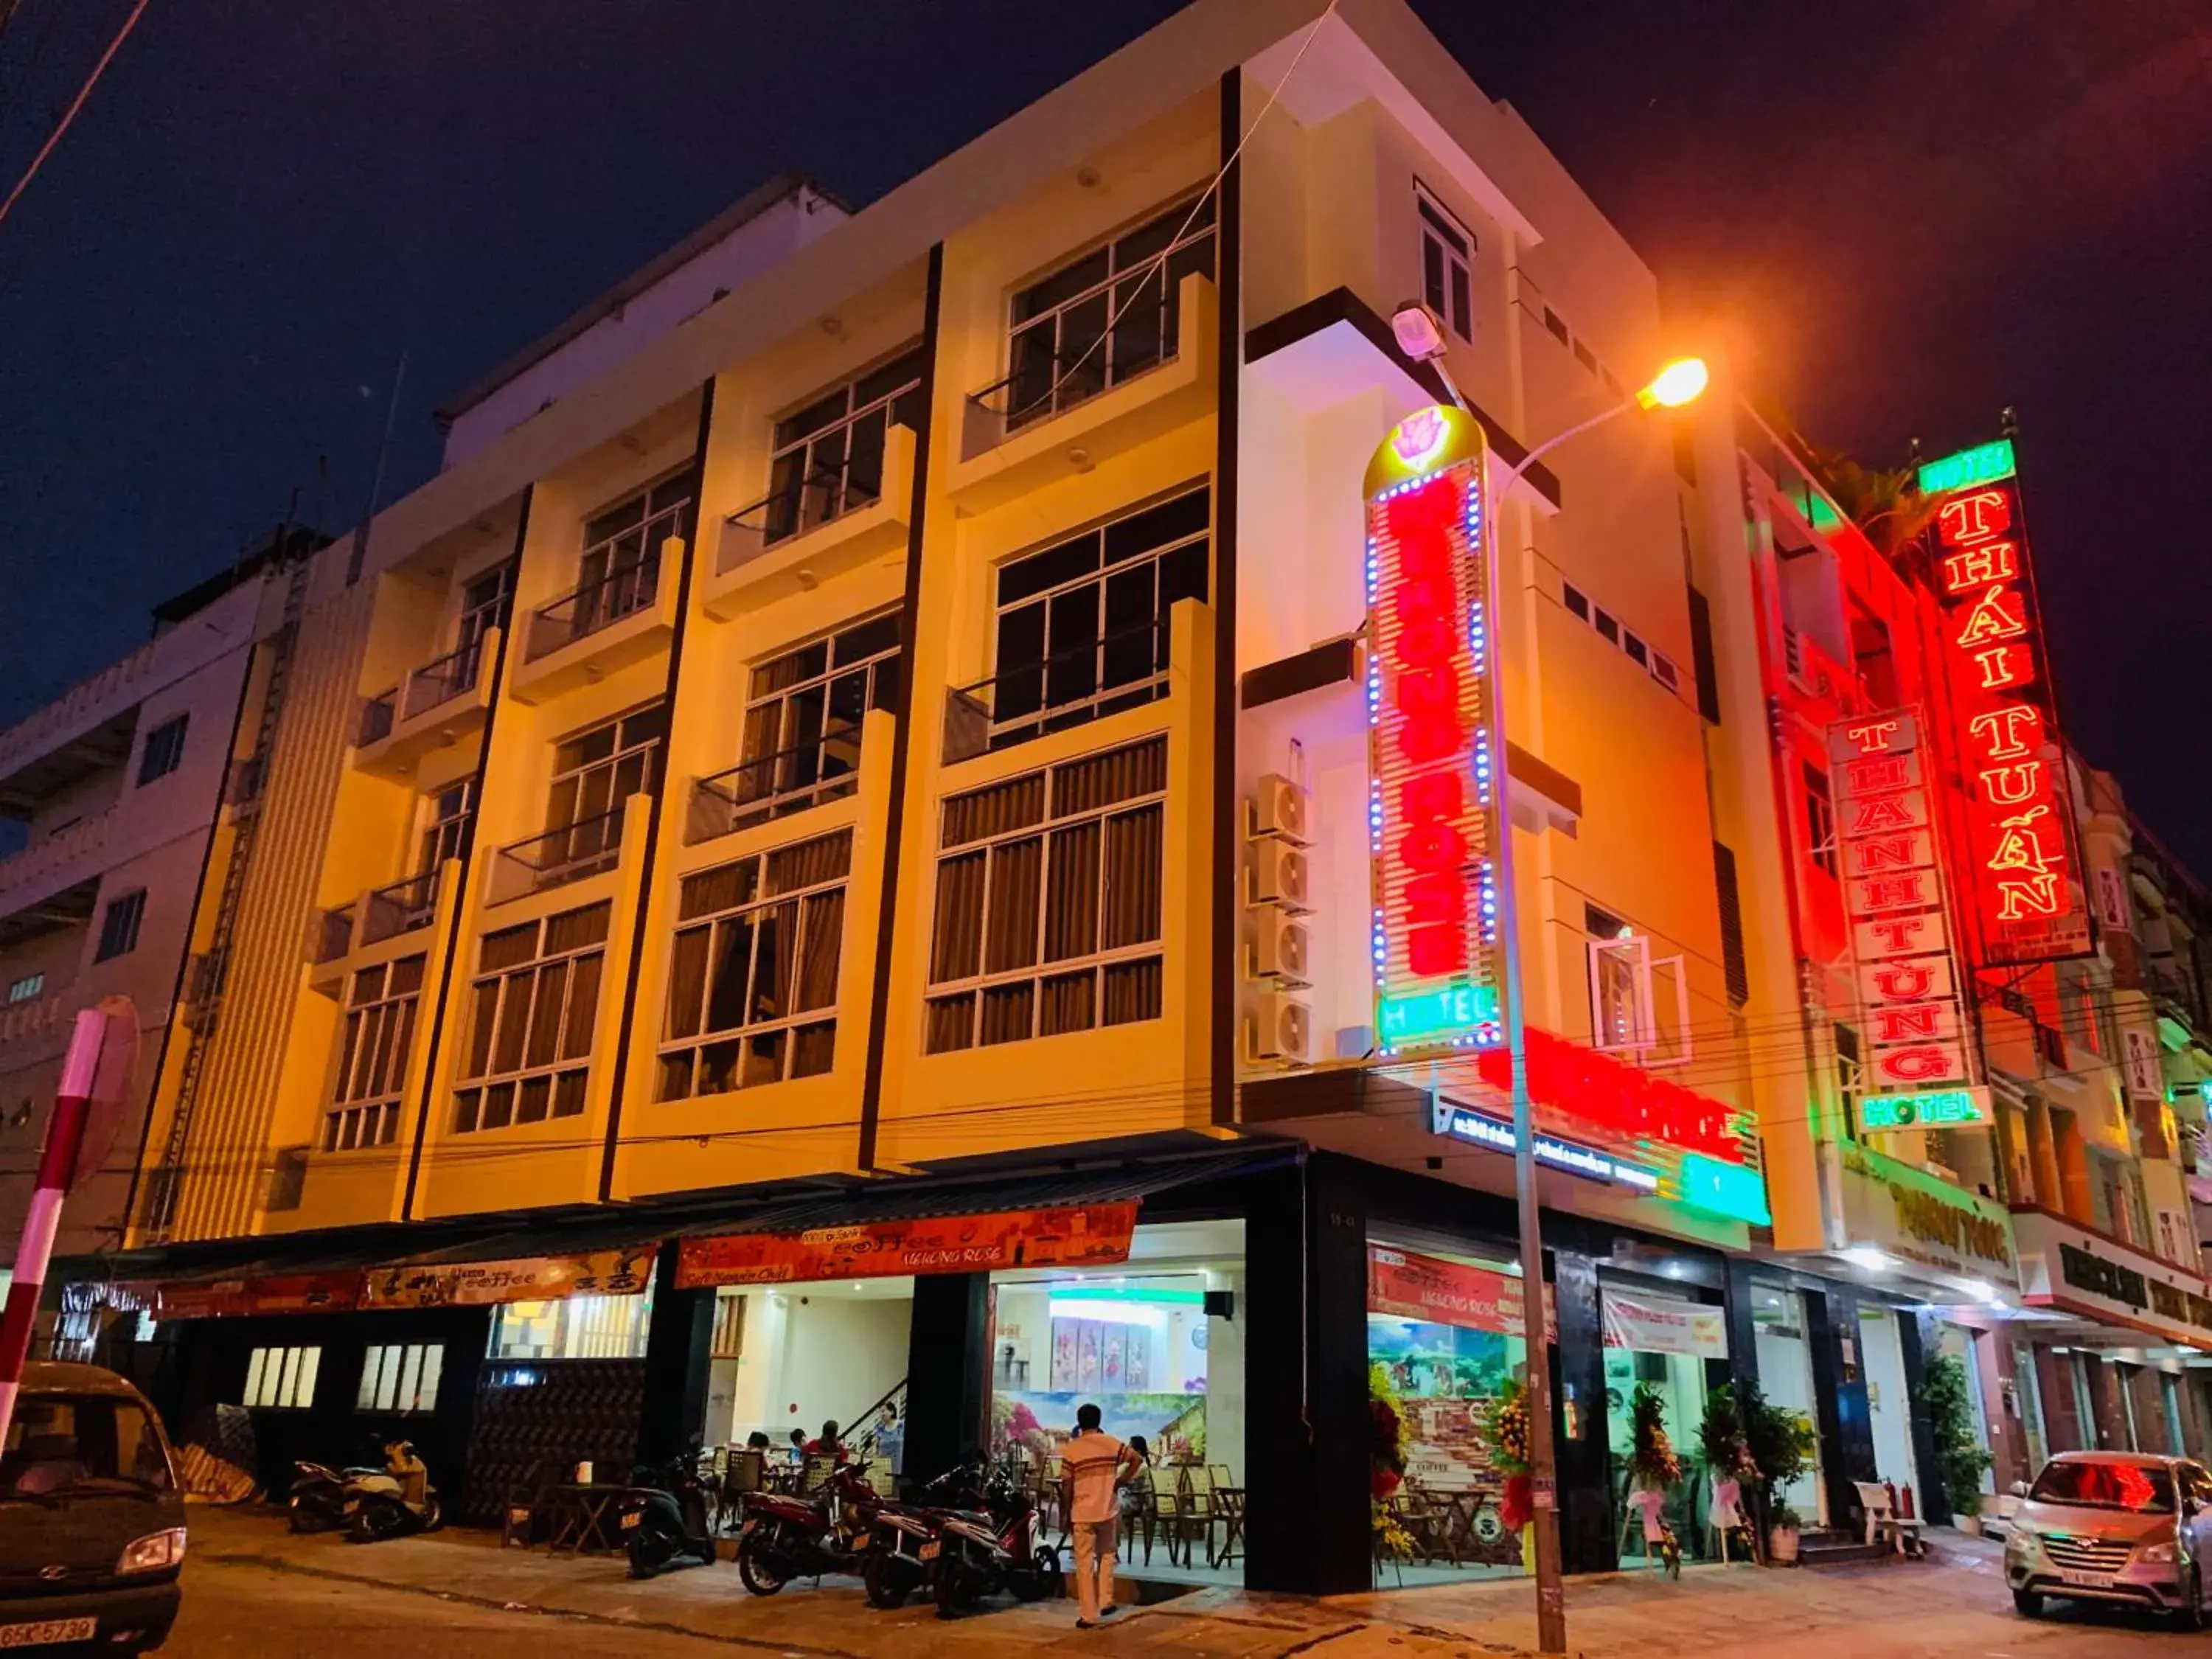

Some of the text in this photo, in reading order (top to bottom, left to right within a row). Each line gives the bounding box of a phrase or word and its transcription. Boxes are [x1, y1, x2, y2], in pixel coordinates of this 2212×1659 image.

[1849, 720, 1952, 1082] THANH TÙNG
[1384, 989, 1488, 1031] HTEL
[1863, 1091, 1983, 1127] HOTEL
